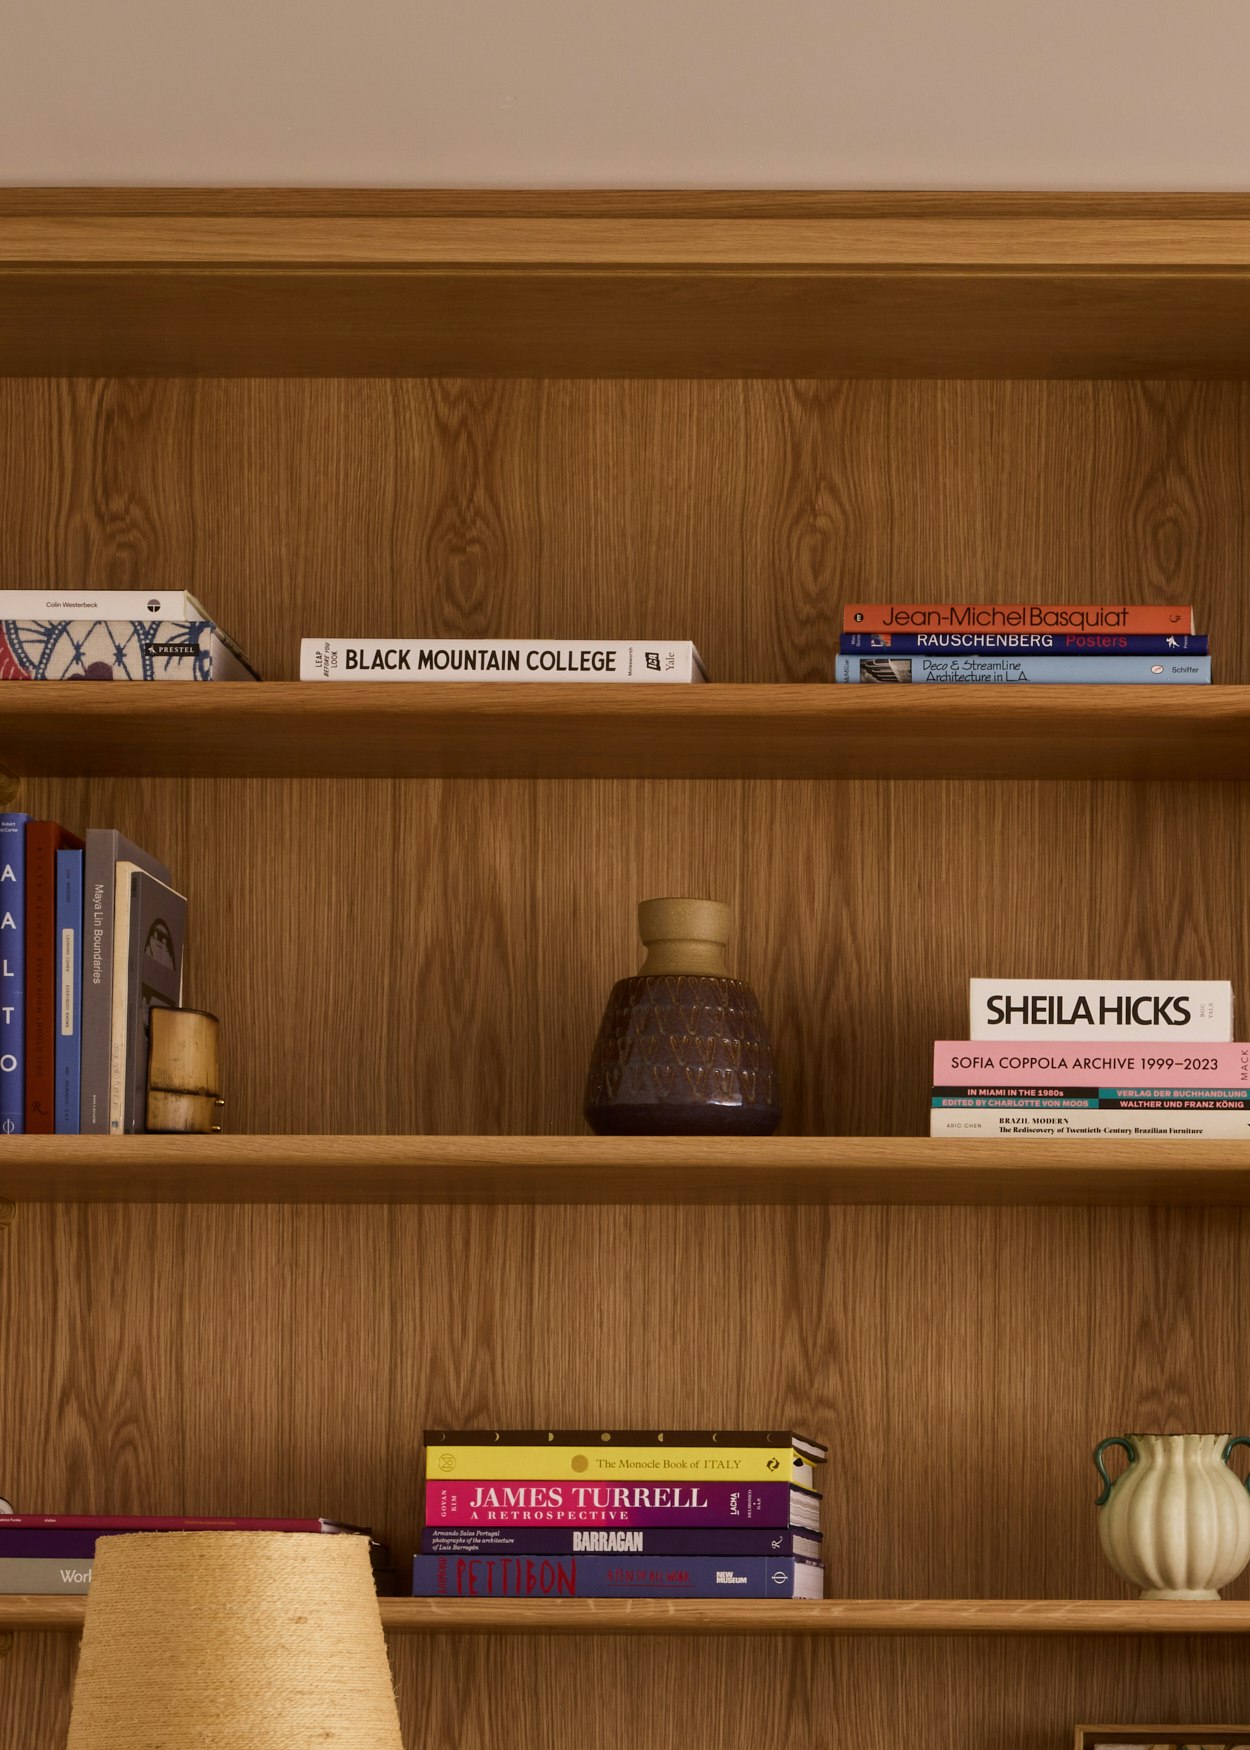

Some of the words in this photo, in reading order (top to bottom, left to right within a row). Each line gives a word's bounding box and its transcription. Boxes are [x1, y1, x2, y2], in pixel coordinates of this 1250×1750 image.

[883, 606, 1027, 628] Jean-Michel
[1030, 607, 1129, 630] Basquiat
[917, 634, 1053, 647] RAUSCHENBERG
[1066, 634, 1128, 648] Posters
[346, 649, 411, 670] BLACK
[418, 650, 520, 671] MOUNTAIN
[527, 651, 617, 672] COLLEGE
[666, 652, 676, 671] Yale
[923, 660, 948, 671] Deco
[951, 660, 960, 671] &
[961, 660, 1021, 671] Streamline
[926, 671, 991, 682] Architecture
[994, 672, 1004, 682] in
[1006, 672, 1031, 682] L.A.
[1172, 666, 1199, 674] Schiffer
[94, 884, 104, 910] Maya
[94, 912, 103, 927] Lin
[93, 930, 103, 984] Boundaries
[987, 996, 1095, 1025] SHEILA
[1099, 996, 1191, 1026] HICKS
[952, 1057, 995, 1069] SOFIA
[1000, 1057, 1068, 1070] COPPOLA
[1073, 1058, 1134, 1070] ARCHIVE
[968, 1089, 976, 1097] IN
[979, 1089, 1005, 1097] MIAMI
[1008, 1089, 1017, 1097] IN
[1117, 1090, 1151, 1098] VERLAG
[1154, 1090, 1171, 1098] DER
[1173, 1090, 1248, 1098] BUCHHANDLUNG
[1120, 1101, 1161, 1109] WALTHER
[1164, 1101, 1184, 1109] UND
[1185, 1101, 1214, 1109] FRANZ
[1216, 1099, 1245, 1109] KÖNIG
[1013, 1127, 1055, 1136] Rediscovery
[1134, 1127, 1168, 1135] Brazilian
[1169, 1127, 1204, 1135] Furniture
[596, 1459, 616, 1469] The
[619, 1459, 660, 1469] Monocle
[661, 1459, 688, 1469] Book
[689, 1459, 700, 1469] of
[704, 1460, 742, 1470] ITALY
[470, 1488, 562, 1508] JAMES
[572, 1487, 708, 1508] TURRELL
[730, 1493, 740, 1516] LACMA
[471, 1511, 479, 1520] A
[488, 1511, 629, 1520] RETROSPECTIVE
[573, 1532, 644, 1552] BARRAGAN
[456, 1557, 577, 1595] PETTIBON
